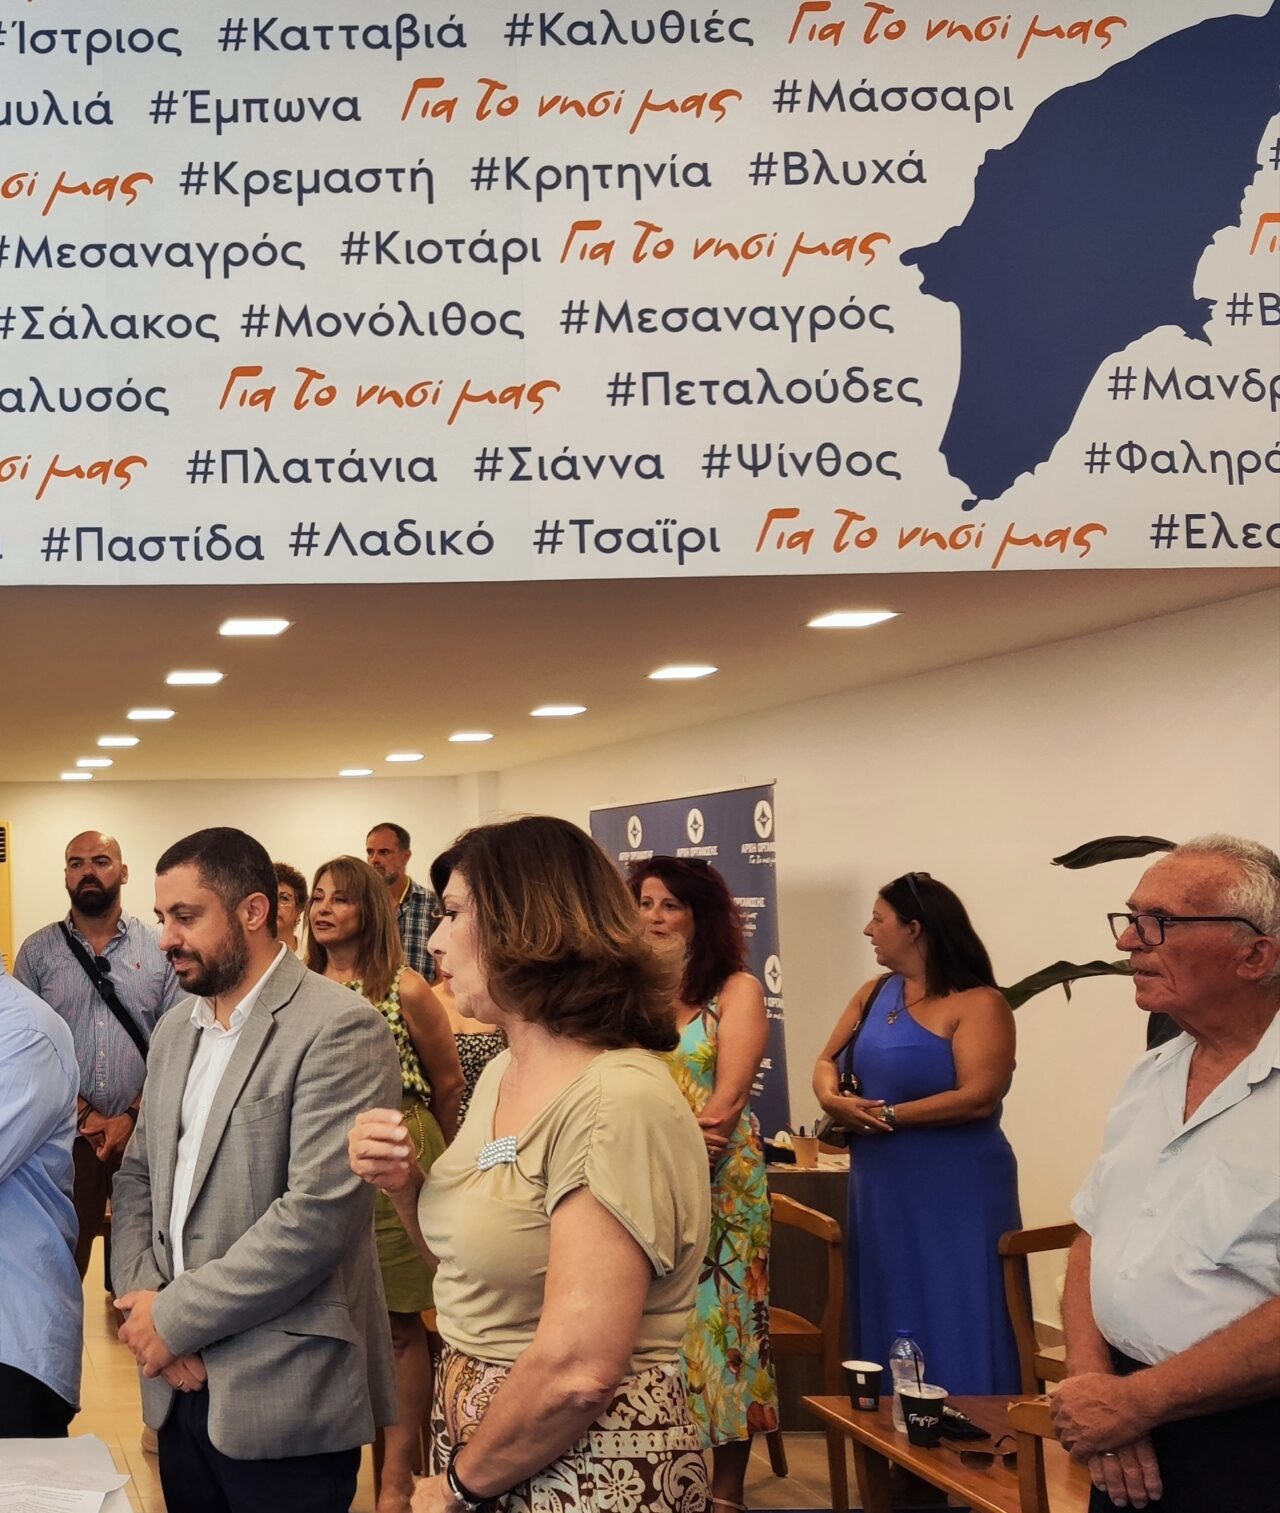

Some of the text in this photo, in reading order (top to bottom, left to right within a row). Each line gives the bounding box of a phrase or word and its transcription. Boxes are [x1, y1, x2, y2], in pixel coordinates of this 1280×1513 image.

[218, 13, 467, 61] #Κατταβιά
[504, 9, 754, 47] #Καλυθιές
[788, 0, 846, 47] Για
[863, 0, 907, 45] το
[924, 16, 1010, 43] νησί
[1016, 16, 1128, 60] μας
[149, 90, 361, 136] #Έμπωνα
[402, 76, 458, 123] Για
[475, 77, 520, 122] το
[538, 90, 623, 118] νησί
[629, 88, 744, 135] μας
[773, 78, 1014, 123] #Μάσσαρι
[42, 172, 154, 216] μας
[179, 158, 434, 207] #Κρεμαστή
[470, 154, 712, 202] #Κρητηνία
[749, 149, 927, 186] #Βλυχά
[341, 229, 541, 275] #Κιοτάρι
[560, 219, 616, 266] Για
[631, 219, 676, 265] το
[692, 232, 776, 261] νησί
[782, 231, 893, 278] μας
[241, 300, 524, 339] #Μονόλιθος
[560, 296, 894, 343] #Μεσαναγρός
[219, 364, 276, 412] Για
[293, 367, 337, 412] το
[355, 380, 442, 409] νησί
[448, 379, 561, 427] μας
[606, 366, 923, 407] #Πεταλούδες
[36, 455, 149, 500] μας
[186, 447, 437, 484] #Πλατάνια
[474, 446, 665, 481] #Σιάννα
[702, 442, 901, 480] #Ψίνθος
[41, 524, 264, 562] #Παστίδα
[289, 519, 494, 556] #Λαδικό
[533, 518, 720, 564] #Τσαΐρι
[755, 507, 816, 555] Για
[832, 507, 880, 554] το
[897, 523, 986, 552] νησί
[993, 522, 1109, 560] μας
